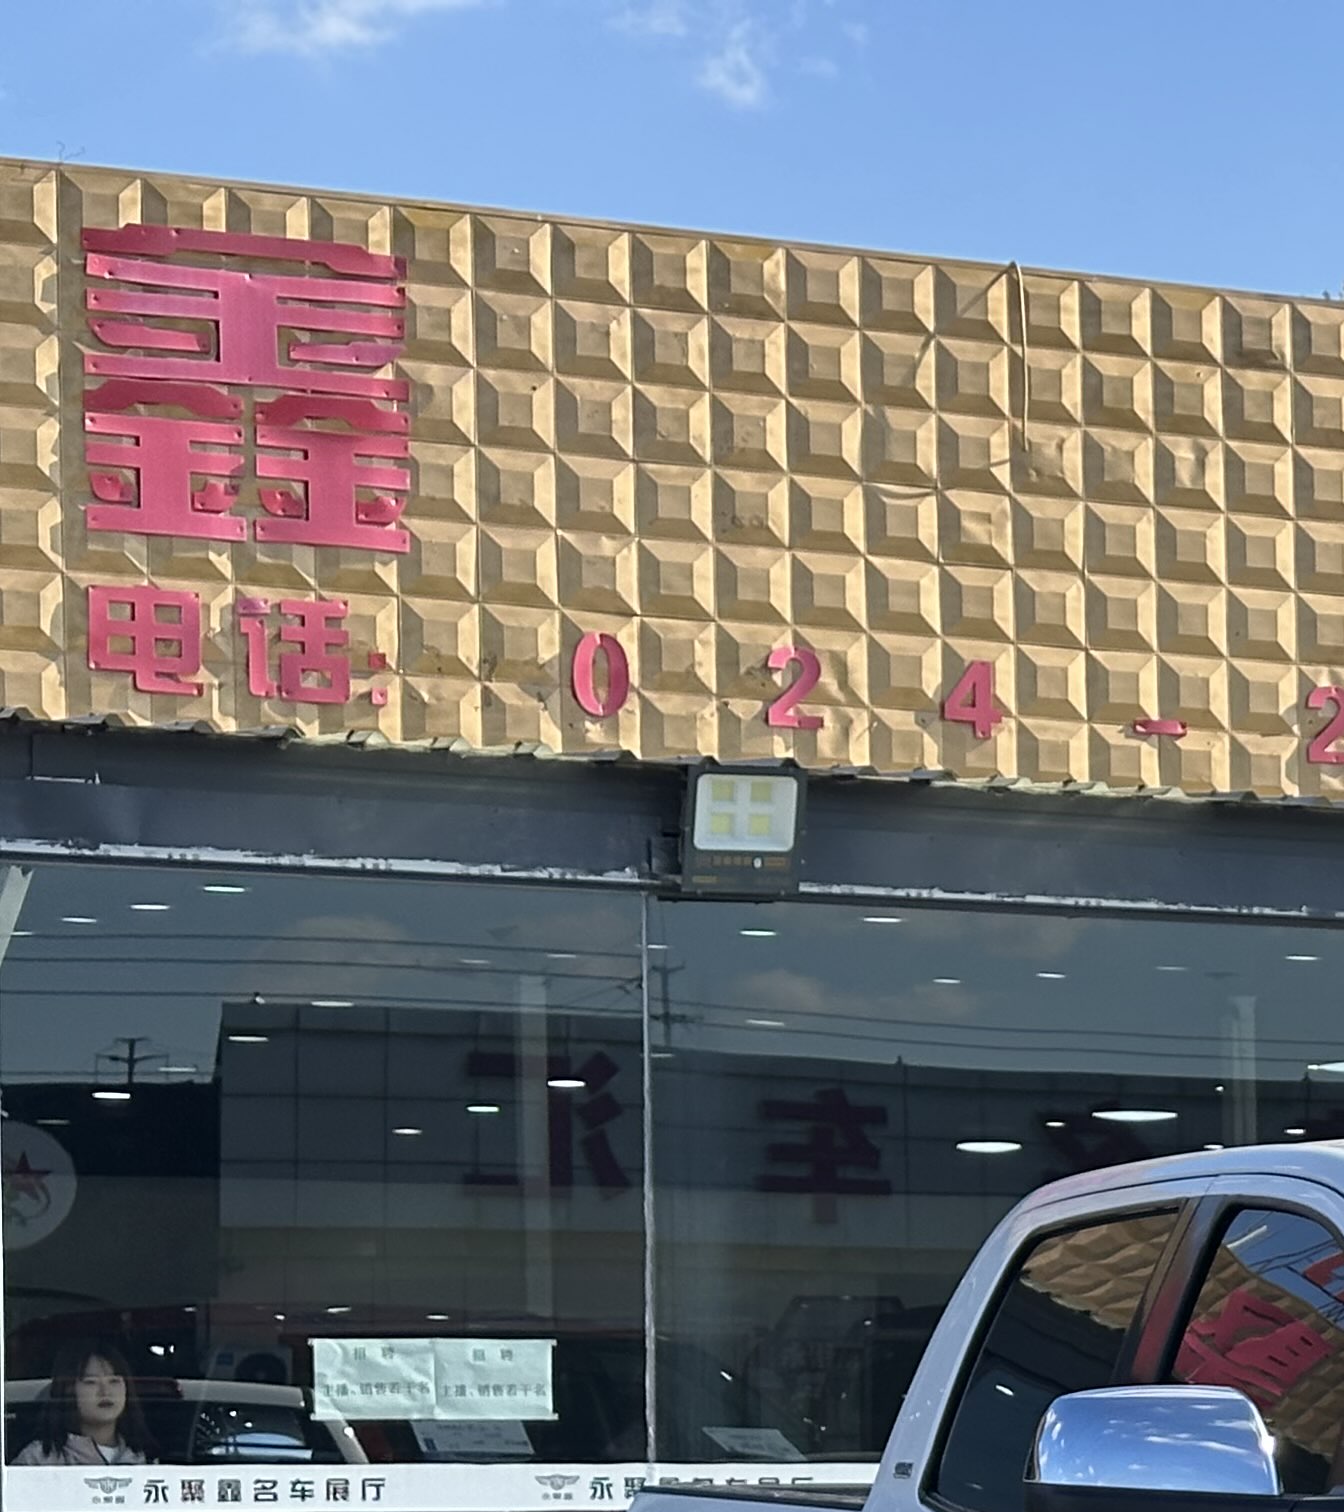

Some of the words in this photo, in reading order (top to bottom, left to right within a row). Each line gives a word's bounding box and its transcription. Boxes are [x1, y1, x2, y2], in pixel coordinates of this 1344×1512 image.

[143, 1477, 386, 1503] 永聚鑫名车展厅
